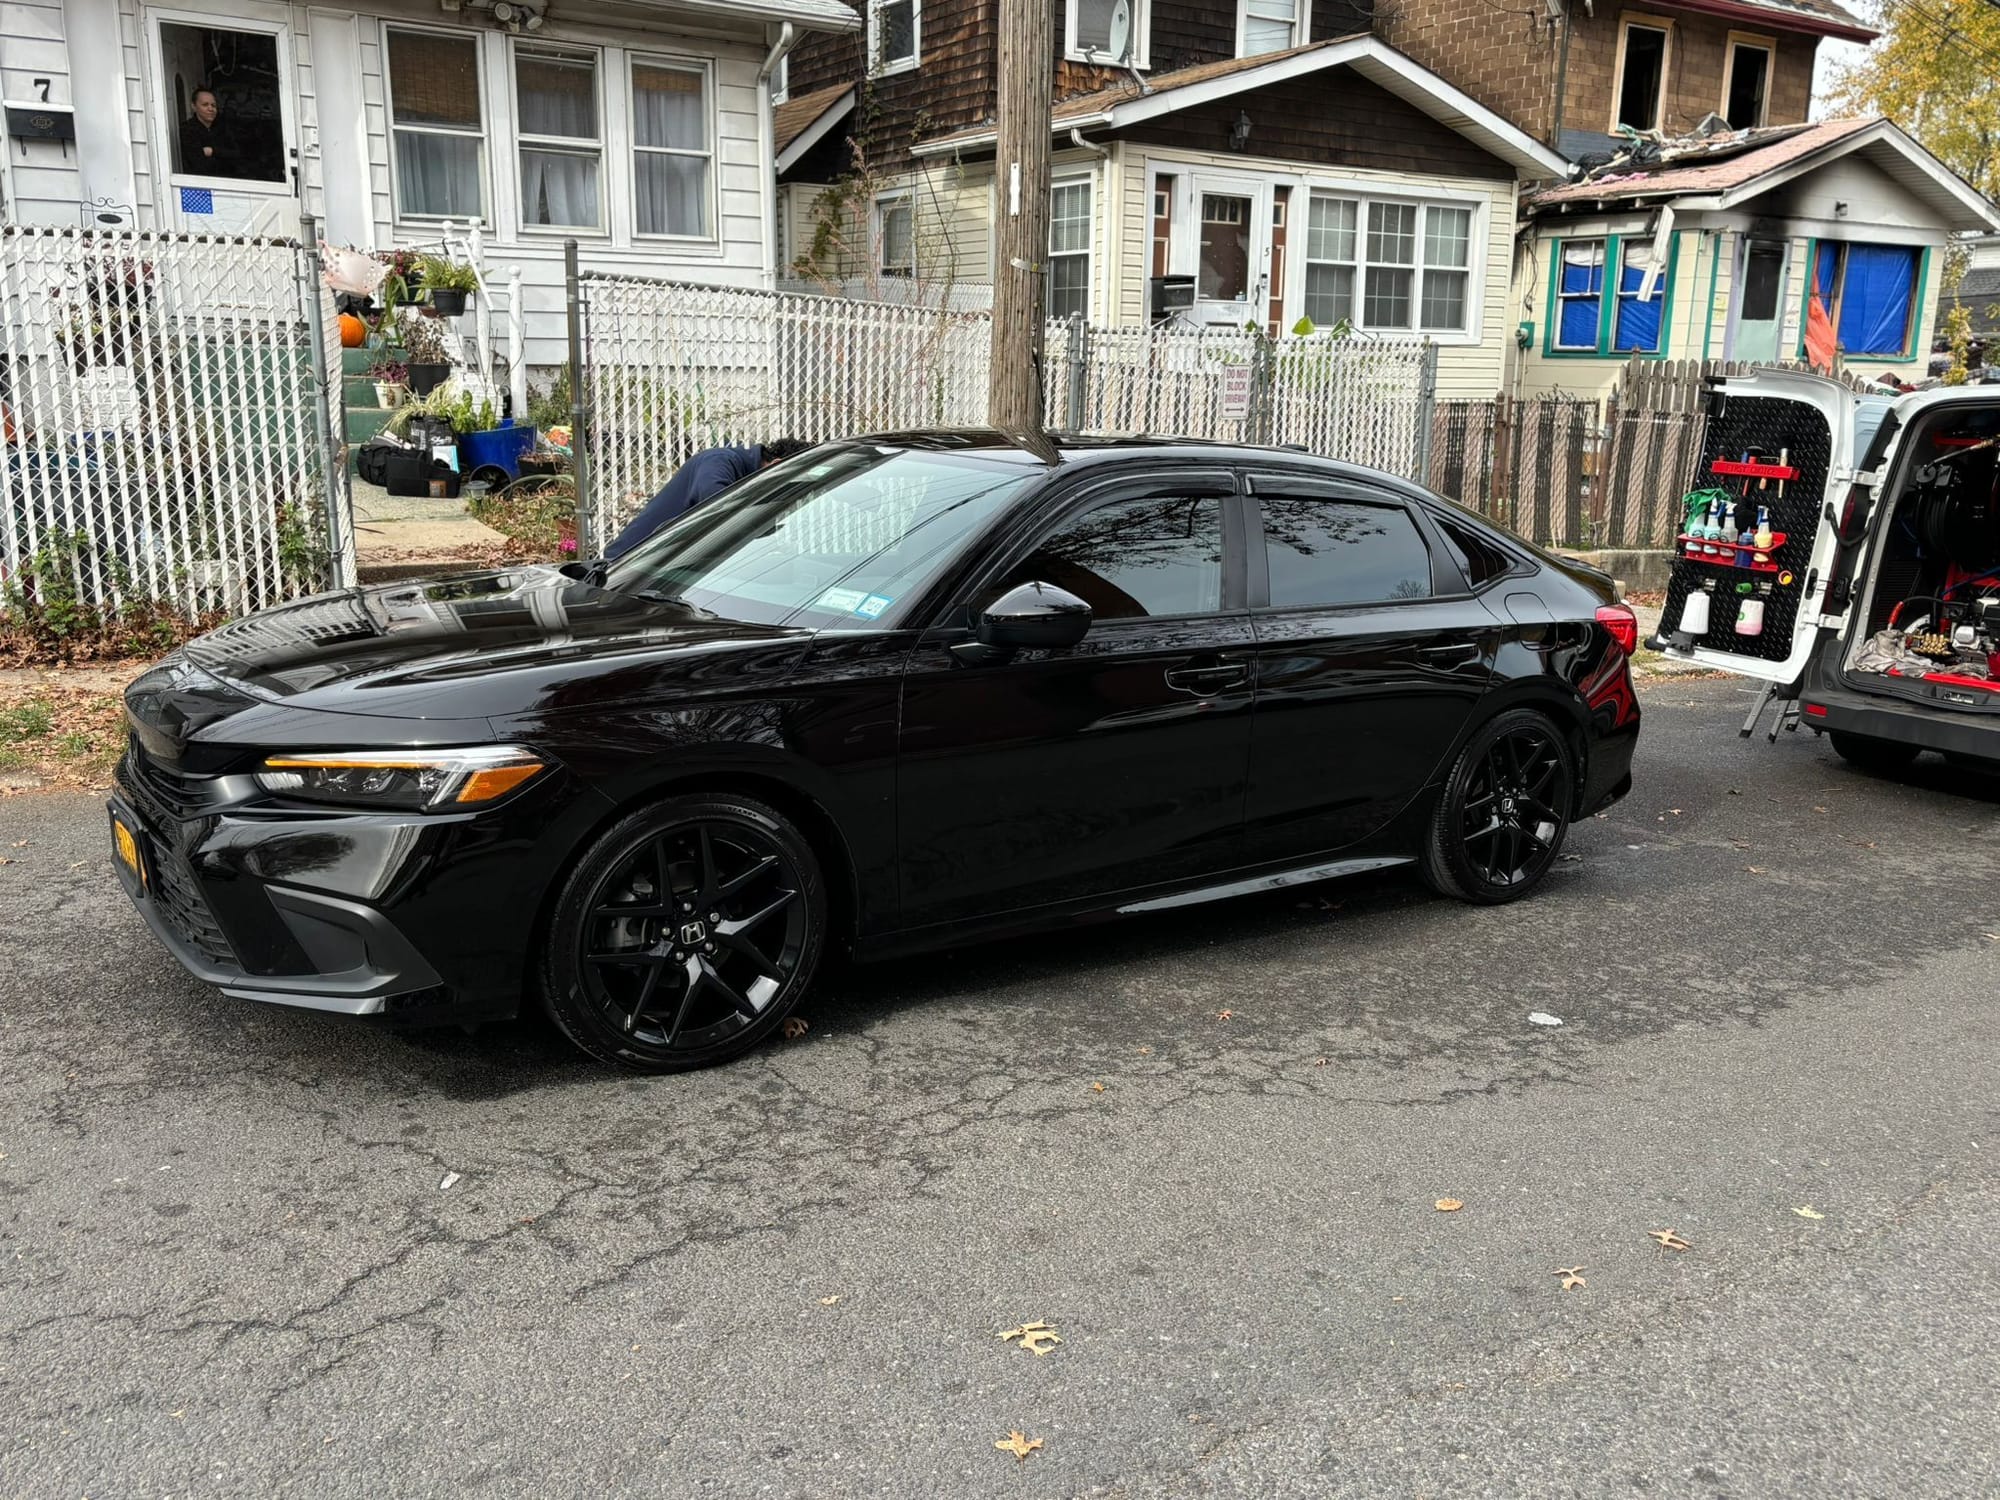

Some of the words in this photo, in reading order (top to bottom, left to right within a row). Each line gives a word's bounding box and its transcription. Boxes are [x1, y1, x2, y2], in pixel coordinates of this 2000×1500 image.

[33, 78, 51, 102] 7
[1263, 246, 1271, 257] 5
[1226, 369, 1236, 379] DO
[1236, 369, 1248, 379] NOT
[1226, 381, 1246, 391] BLOCK
[1224, 393, 1247, 404] DRIVEWAY
[1727, 464, 1747, 473] FIRST
